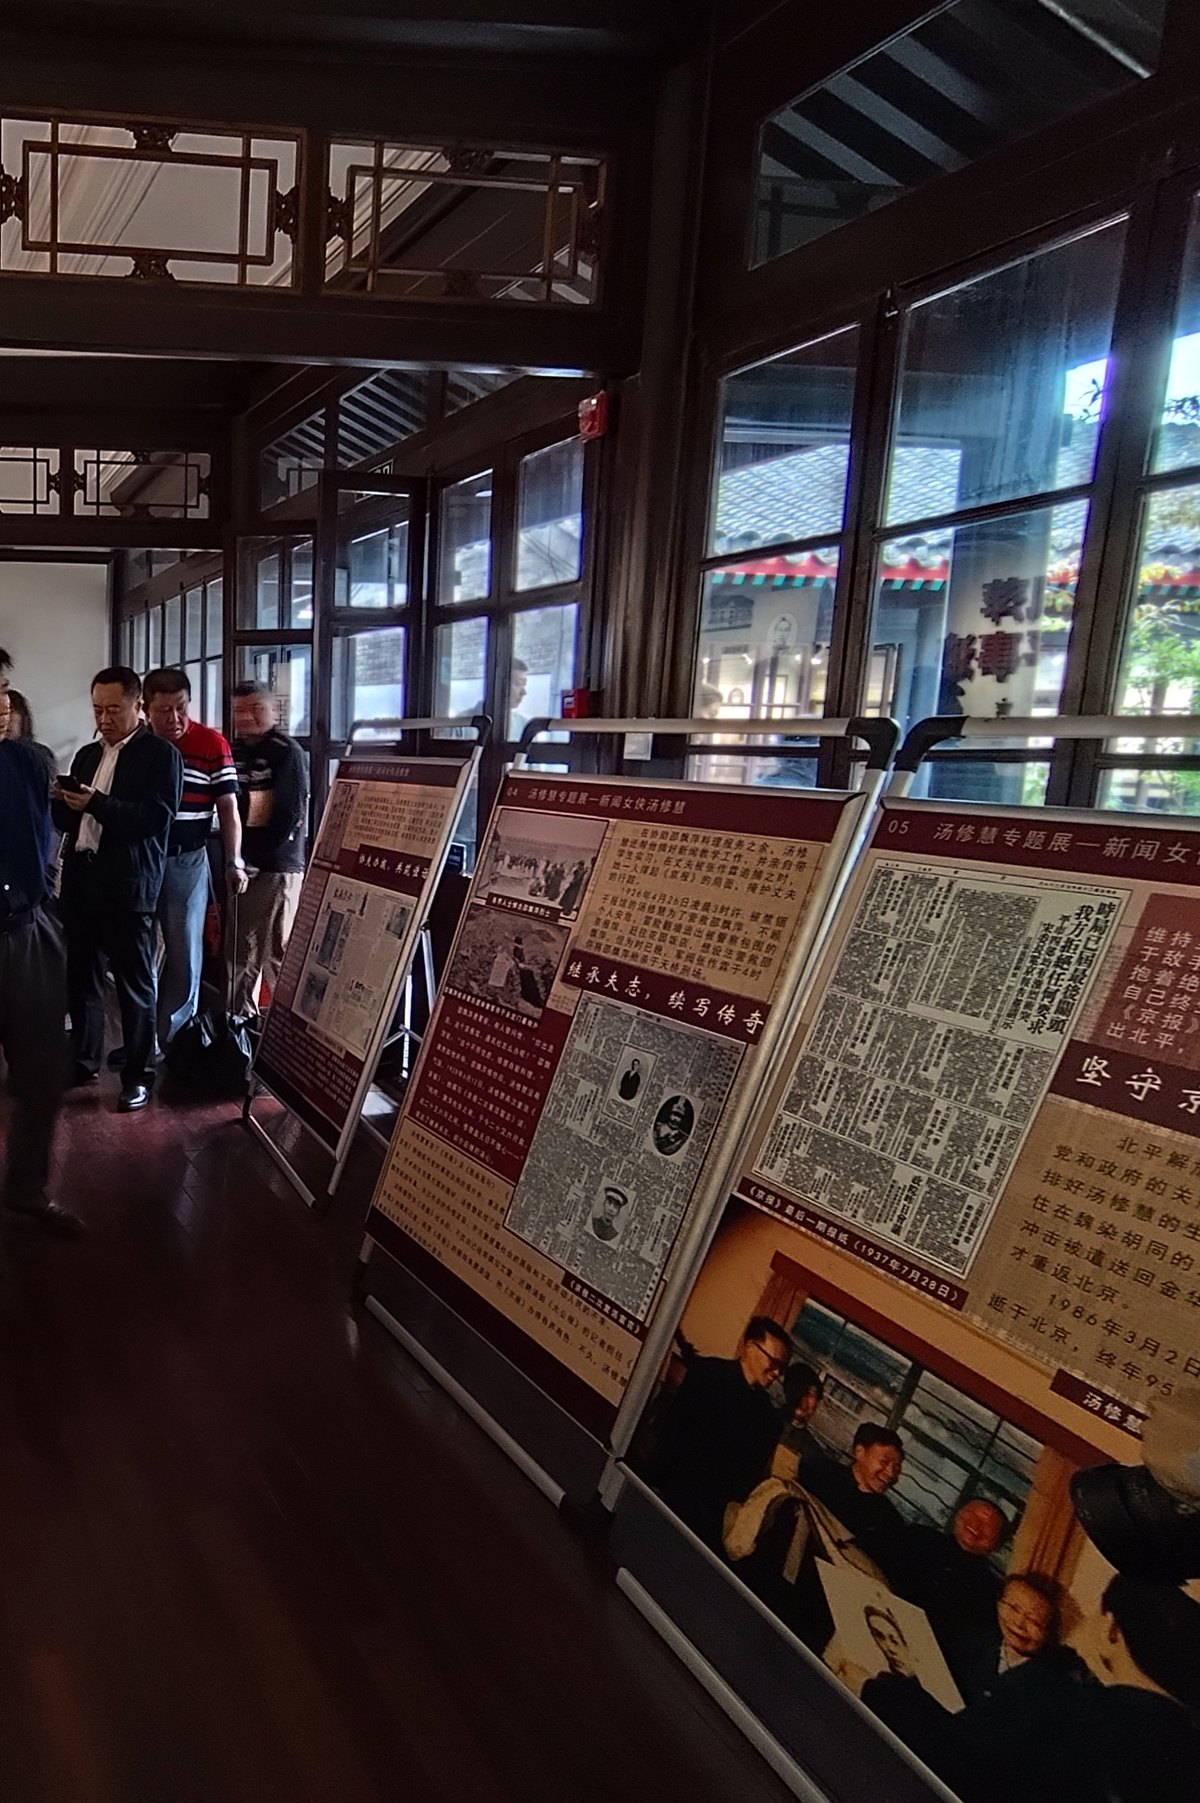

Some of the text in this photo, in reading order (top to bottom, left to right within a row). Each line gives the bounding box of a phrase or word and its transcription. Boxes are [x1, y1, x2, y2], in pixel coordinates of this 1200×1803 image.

[887, 820, 1200, 865] 05 汤修慧专题展—新闻女
[1145, 926, 1200, 951] 维持
[1123, 984, 1200, 1014] 自己终
[1053, 1144, 1200, 1209] 党和政府的关
[1032, 1194, 1200, 1276] 住在魏染胡同的
